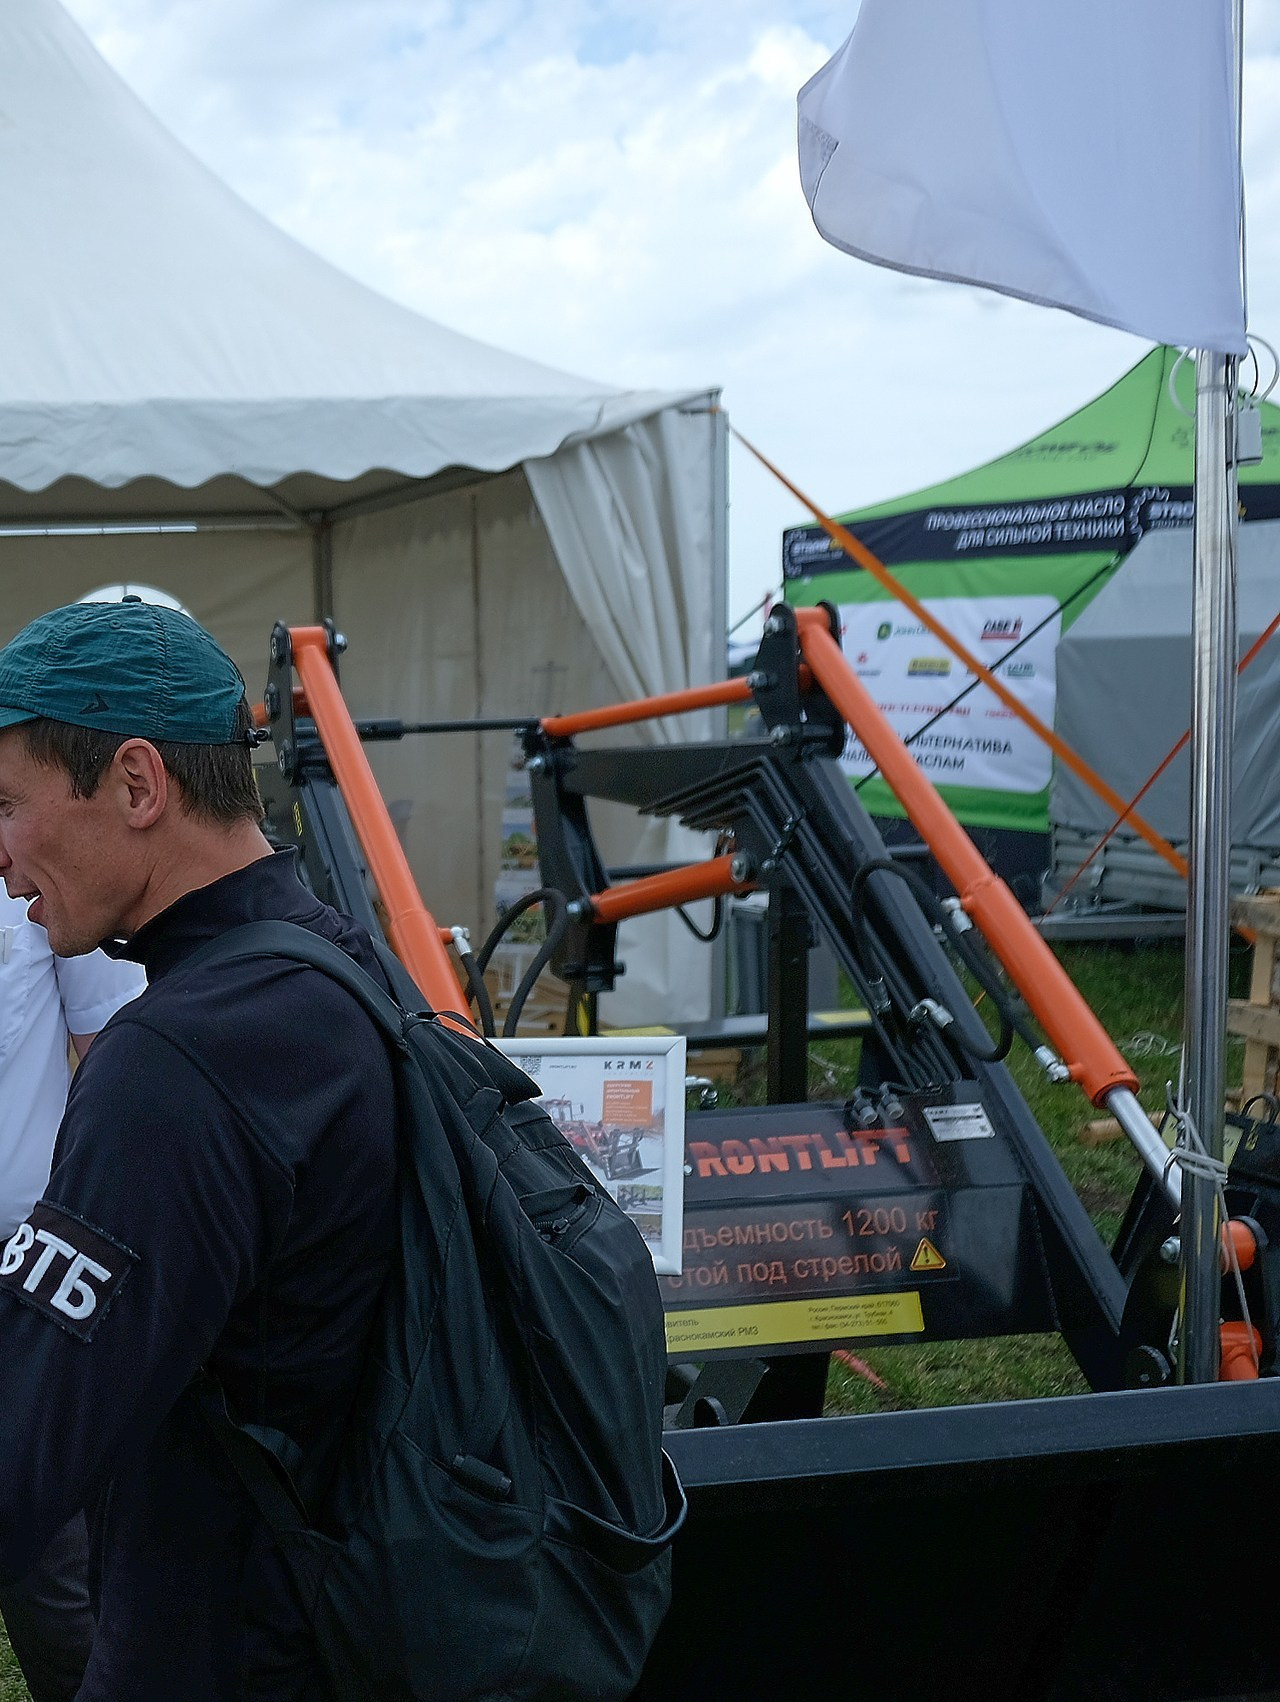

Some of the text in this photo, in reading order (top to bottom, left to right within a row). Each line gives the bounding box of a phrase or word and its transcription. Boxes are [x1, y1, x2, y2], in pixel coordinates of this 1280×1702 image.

[927, 499, 1070, 531] ПРОФЕССИОНАЛЬНОЕ
[1071, 495, 1126, 521] МАСЛО
[956, 517, 1126, 550] ДЛЯ СИЛЬНОЙ ТЕХНИКИ
[904, 732, 1013, 755] АЛЬТЕРНАТИВА
[604, 1060, 654, 1070] KRMZ
[686, 1127, 912, 1178] RONTLIFT
[683, 1206, 939, 1252] дъемность 1200 кг
[667, 1245, 903, 1288] стой под стрелой
[666, 1325, 759, 1343] раснокамский РМЗ
